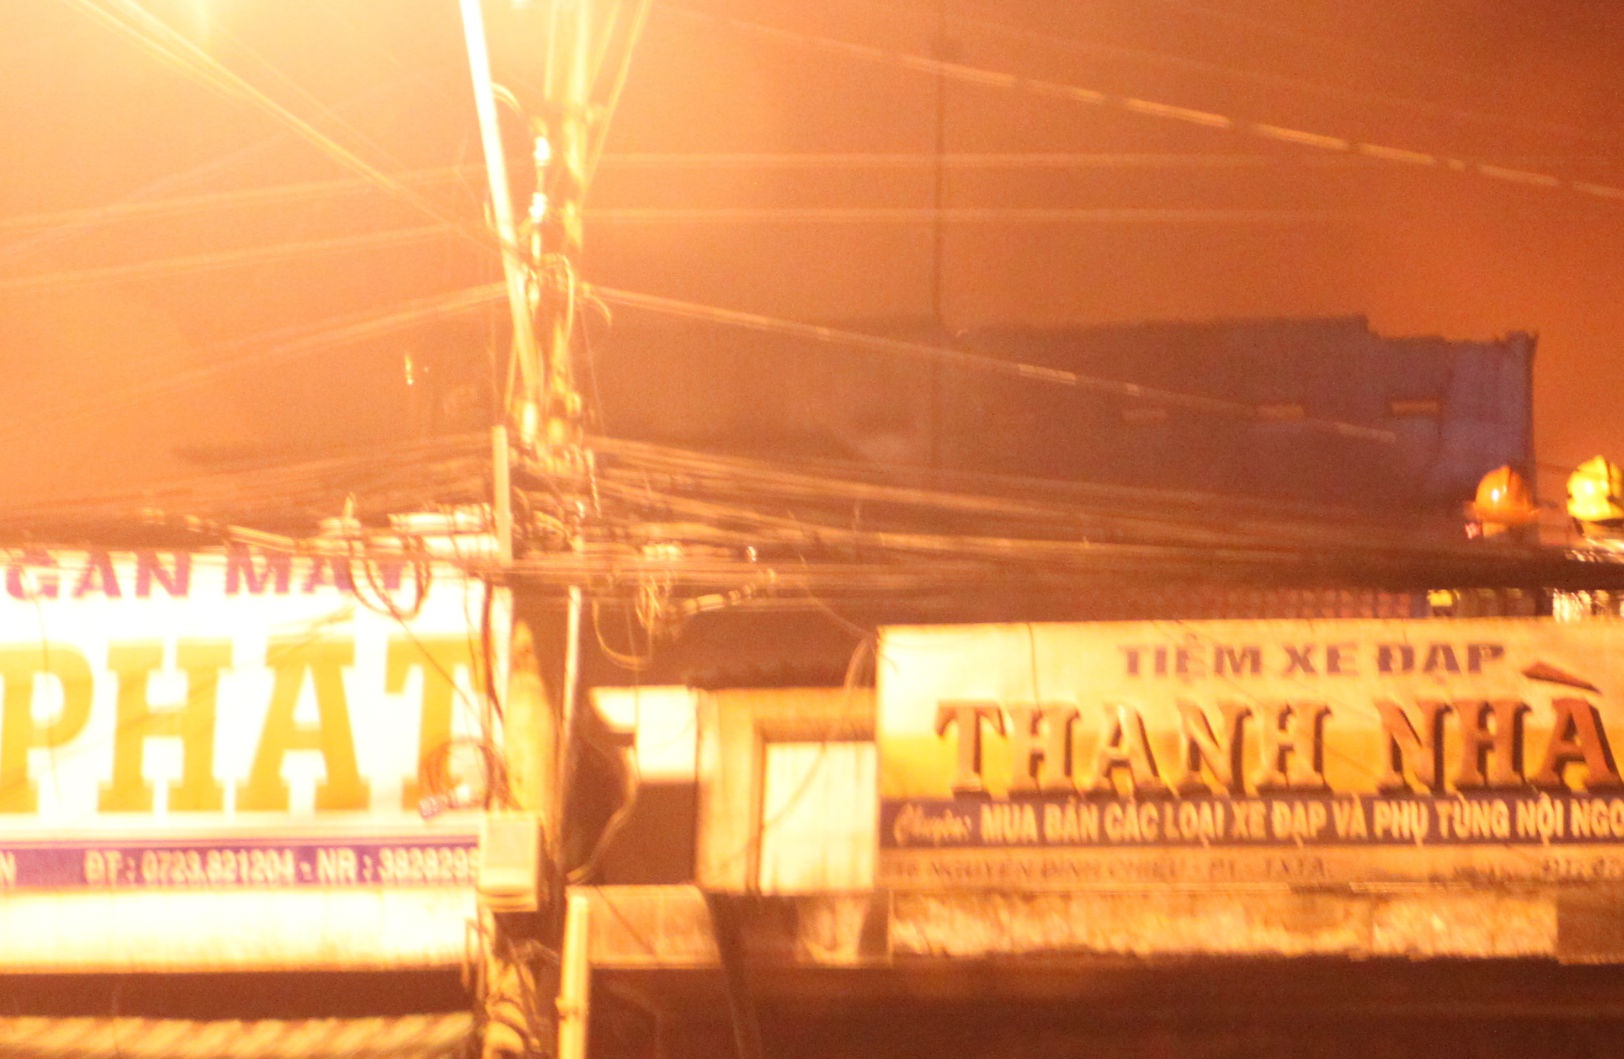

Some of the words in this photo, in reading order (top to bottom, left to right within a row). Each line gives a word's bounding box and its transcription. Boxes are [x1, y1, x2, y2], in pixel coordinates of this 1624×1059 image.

[1284, 644, 1358, 674] XE
[936, 697, 1332, 797] THANH
[980, 803, 1038, 842] MUA
[1232, 801, 1266, 840] XE
